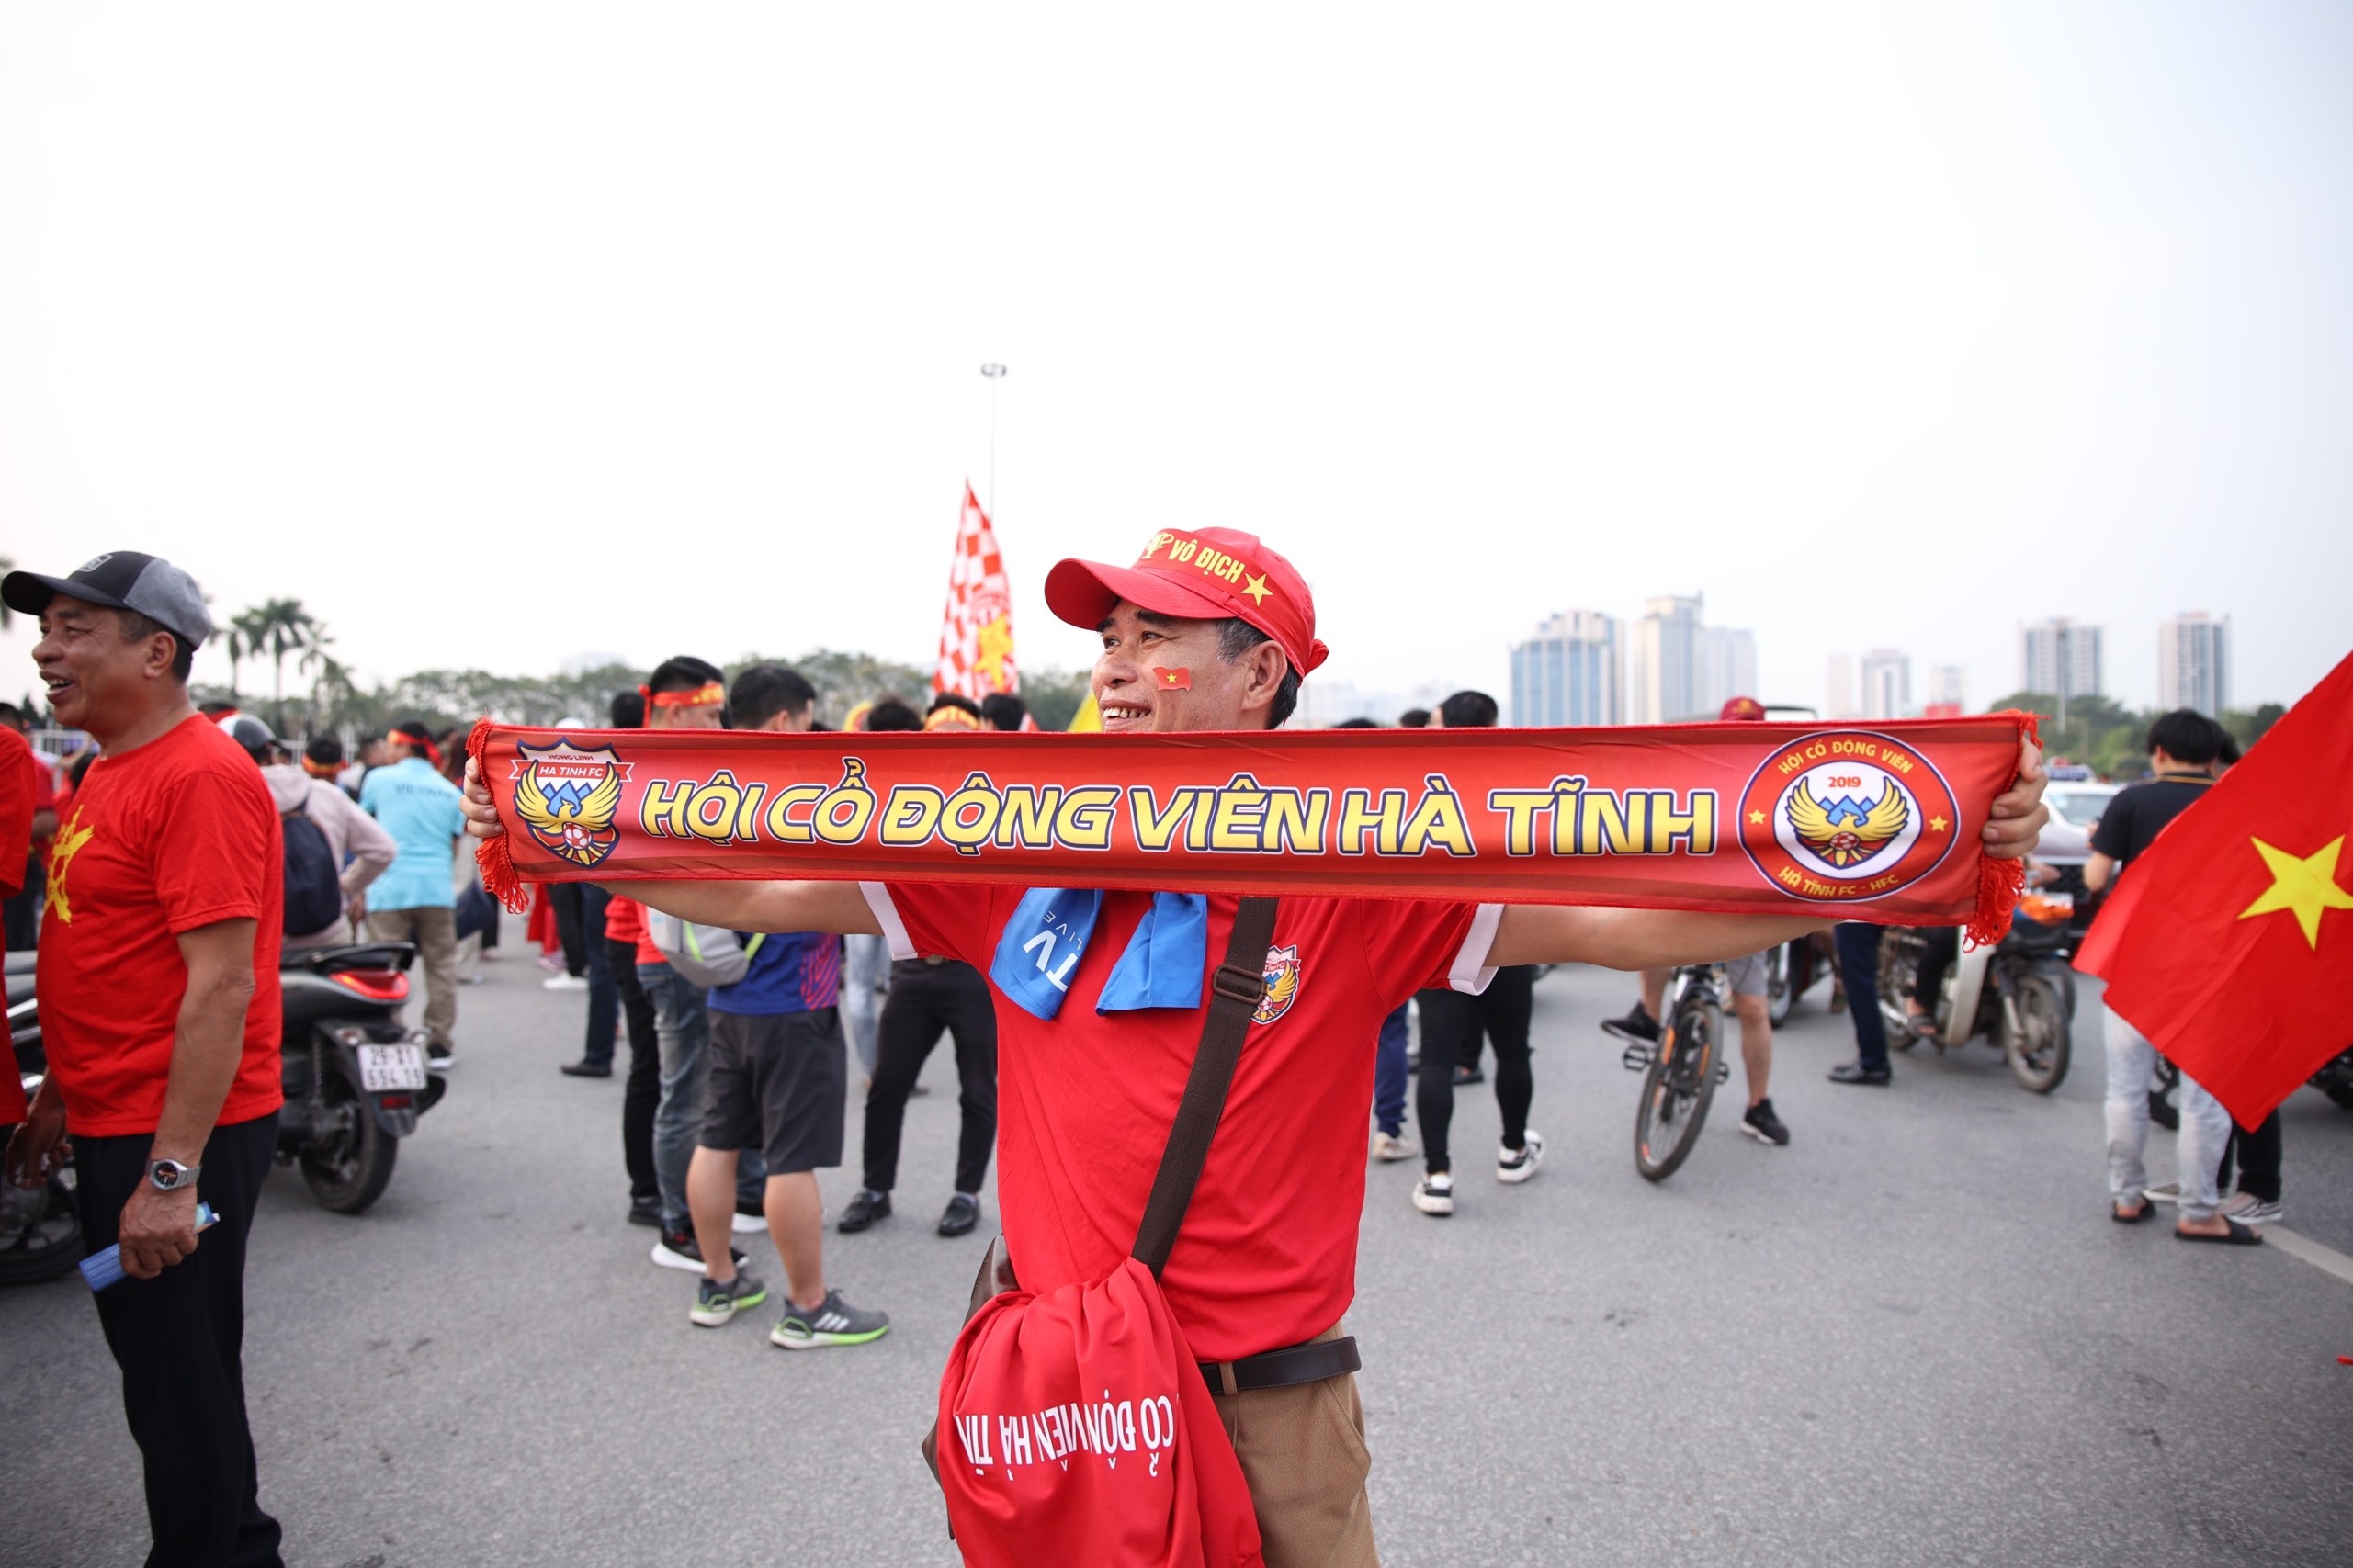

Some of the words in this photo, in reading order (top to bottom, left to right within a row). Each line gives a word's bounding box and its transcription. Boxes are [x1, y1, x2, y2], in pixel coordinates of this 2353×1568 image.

[1167, 538, 1198, 563] VÔ
[1195, 547, 1246, 584] ĐỊCH
[539, 766, 557, 775] HA
[559, 766, 586, 776] TINH
[588, 767, 604, 777] FC
[1777, 752, 1804, 775] HỘI
[1805, 739, 1827, 760] CỔ
[1832, 739, 1876, 757] ĐỘNG
[1881, 748, 1914, 774] VIÊN
[1827, 776, 1861, 788] 2019
[641, 770, 765, 846] HỘI
[766, 756, 877, 846] CỔ
[880, 772, 1121, 856] ĐỘNG
[1129, 773, 1332, 856] VIÊN
[1337, 773, 1476, 857] HÀ
[1488, 775, 1719, 857] TĨNH
[1778, 865, 1802, 887] HÀ
[1804, 879, 1837, 897] TĨNH
[1838, 886, 1857, 896] FC
[1869, 874, 1899, 891] HFC
[1023, 929, 1079, 993] TV
[1043, 910, 1083, 951] LIVE
[953, 1414, 993, 1476] TĨN
[998, 1414, 1033, 1481] HÀ
[1032, 1403, 1089, 1471] VIÊN
[1084, 1389, 1136, 1470] ĐỘN
[1140, 1395, 1174, 1477] CỔ
